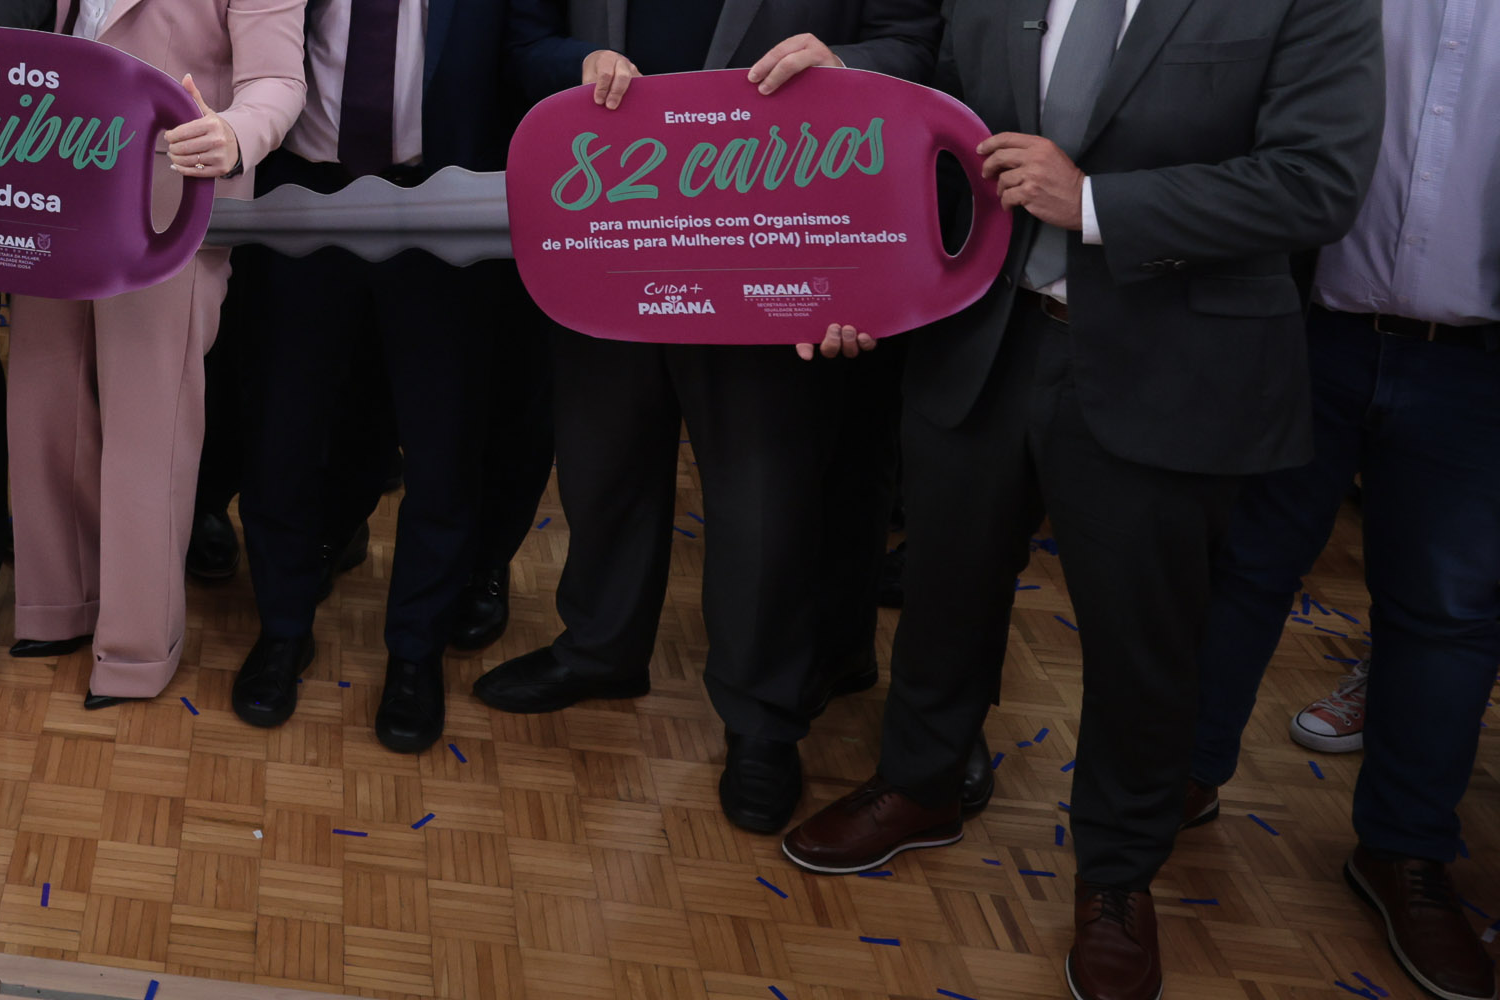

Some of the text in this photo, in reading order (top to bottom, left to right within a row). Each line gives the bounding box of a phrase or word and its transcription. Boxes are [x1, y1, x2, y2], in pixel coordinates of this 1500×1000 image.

[8, 62, 60, 89] dos
[664, 108, 751, 126] Entrega de
[551, 117, 885, 211] 82 carros
[589, 211, 851, 233] para municípios com Organismos
[542, 228, 908, 251] de Políticas para Mulheres (OPM) implantados
[644, 281, 704, 296] CUIDA +
[743, 281, 813, 295] PARANÁ
[637, 299, 716, 315] PARANÁ
